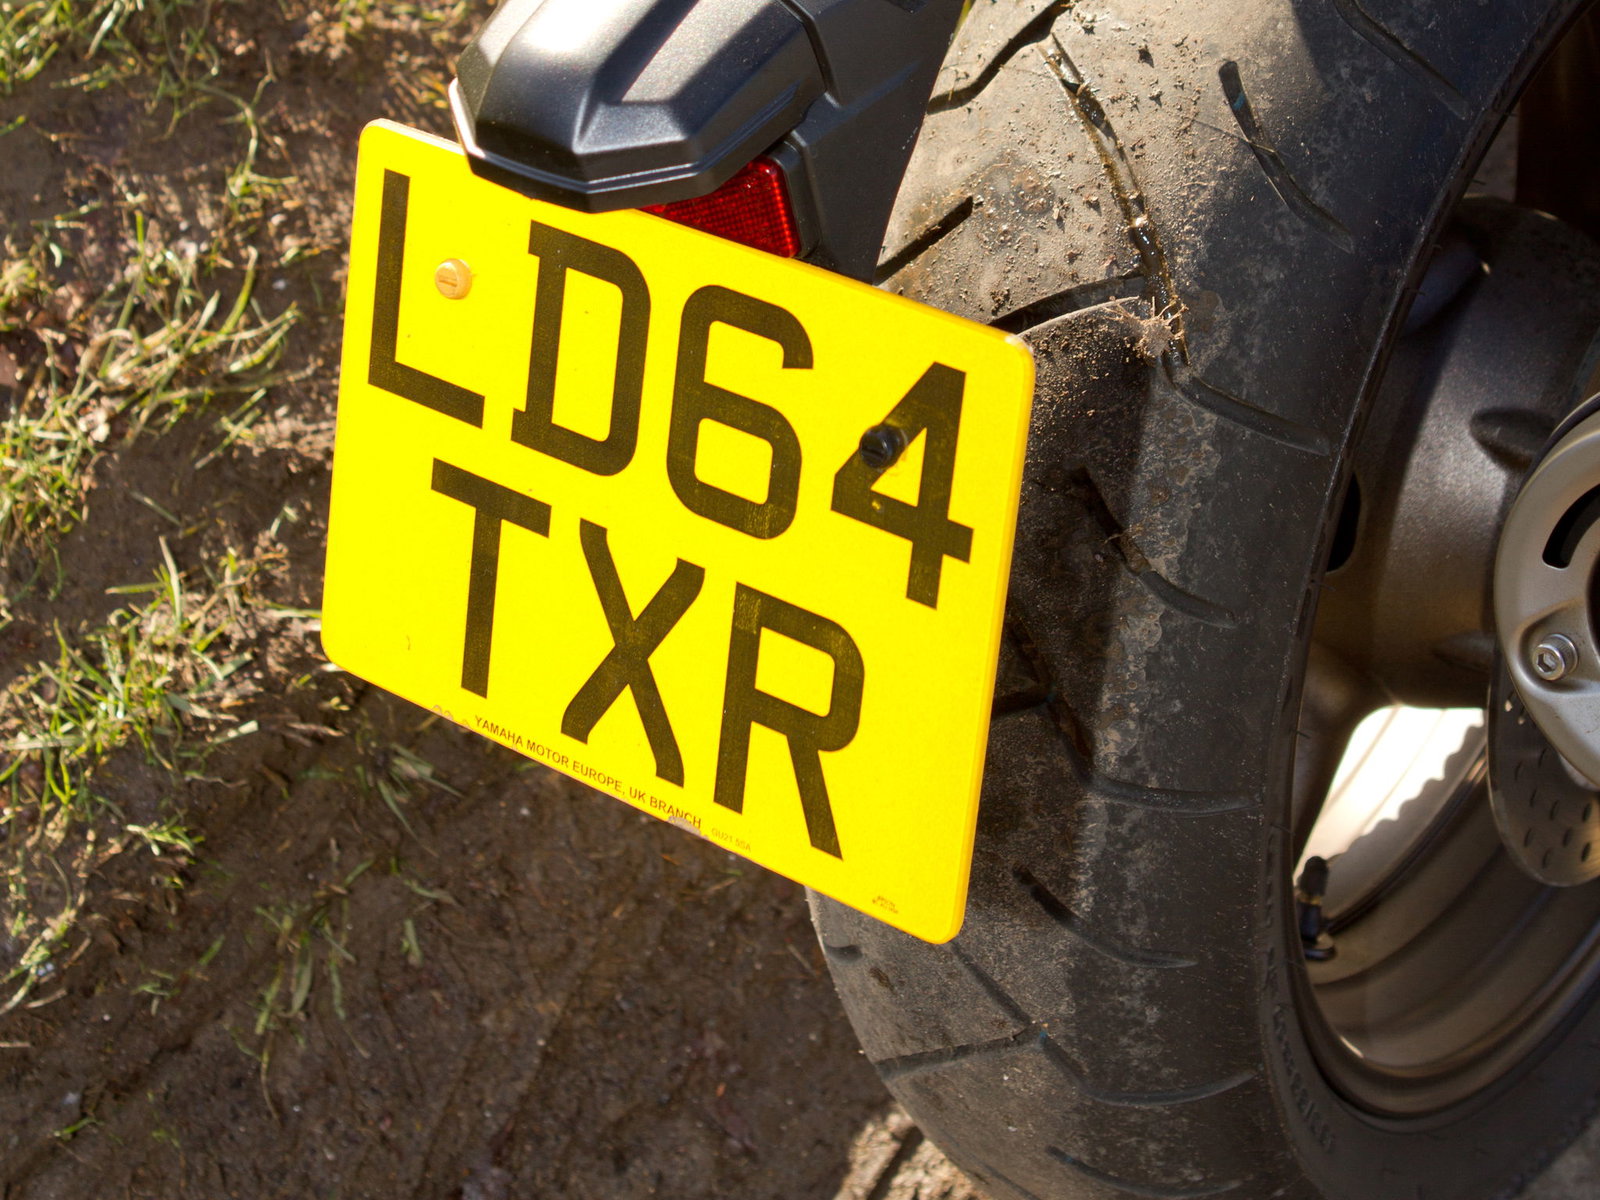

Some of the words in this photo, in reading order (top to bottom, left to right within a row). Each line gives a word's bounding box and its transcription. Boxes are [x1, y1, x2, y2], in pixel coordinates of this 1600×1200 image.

[368, 170, 974, 610] LD64
[431, 458, 865, 860] TXR
[474, 714, 524, 748] YAMAHA
[526, 740, 569, 768] MOTOR
[572, 760, 626, 795] EUROPE,
[629, 786, 646, 803] UK
[649, 796, 702, 829] BRANCH
